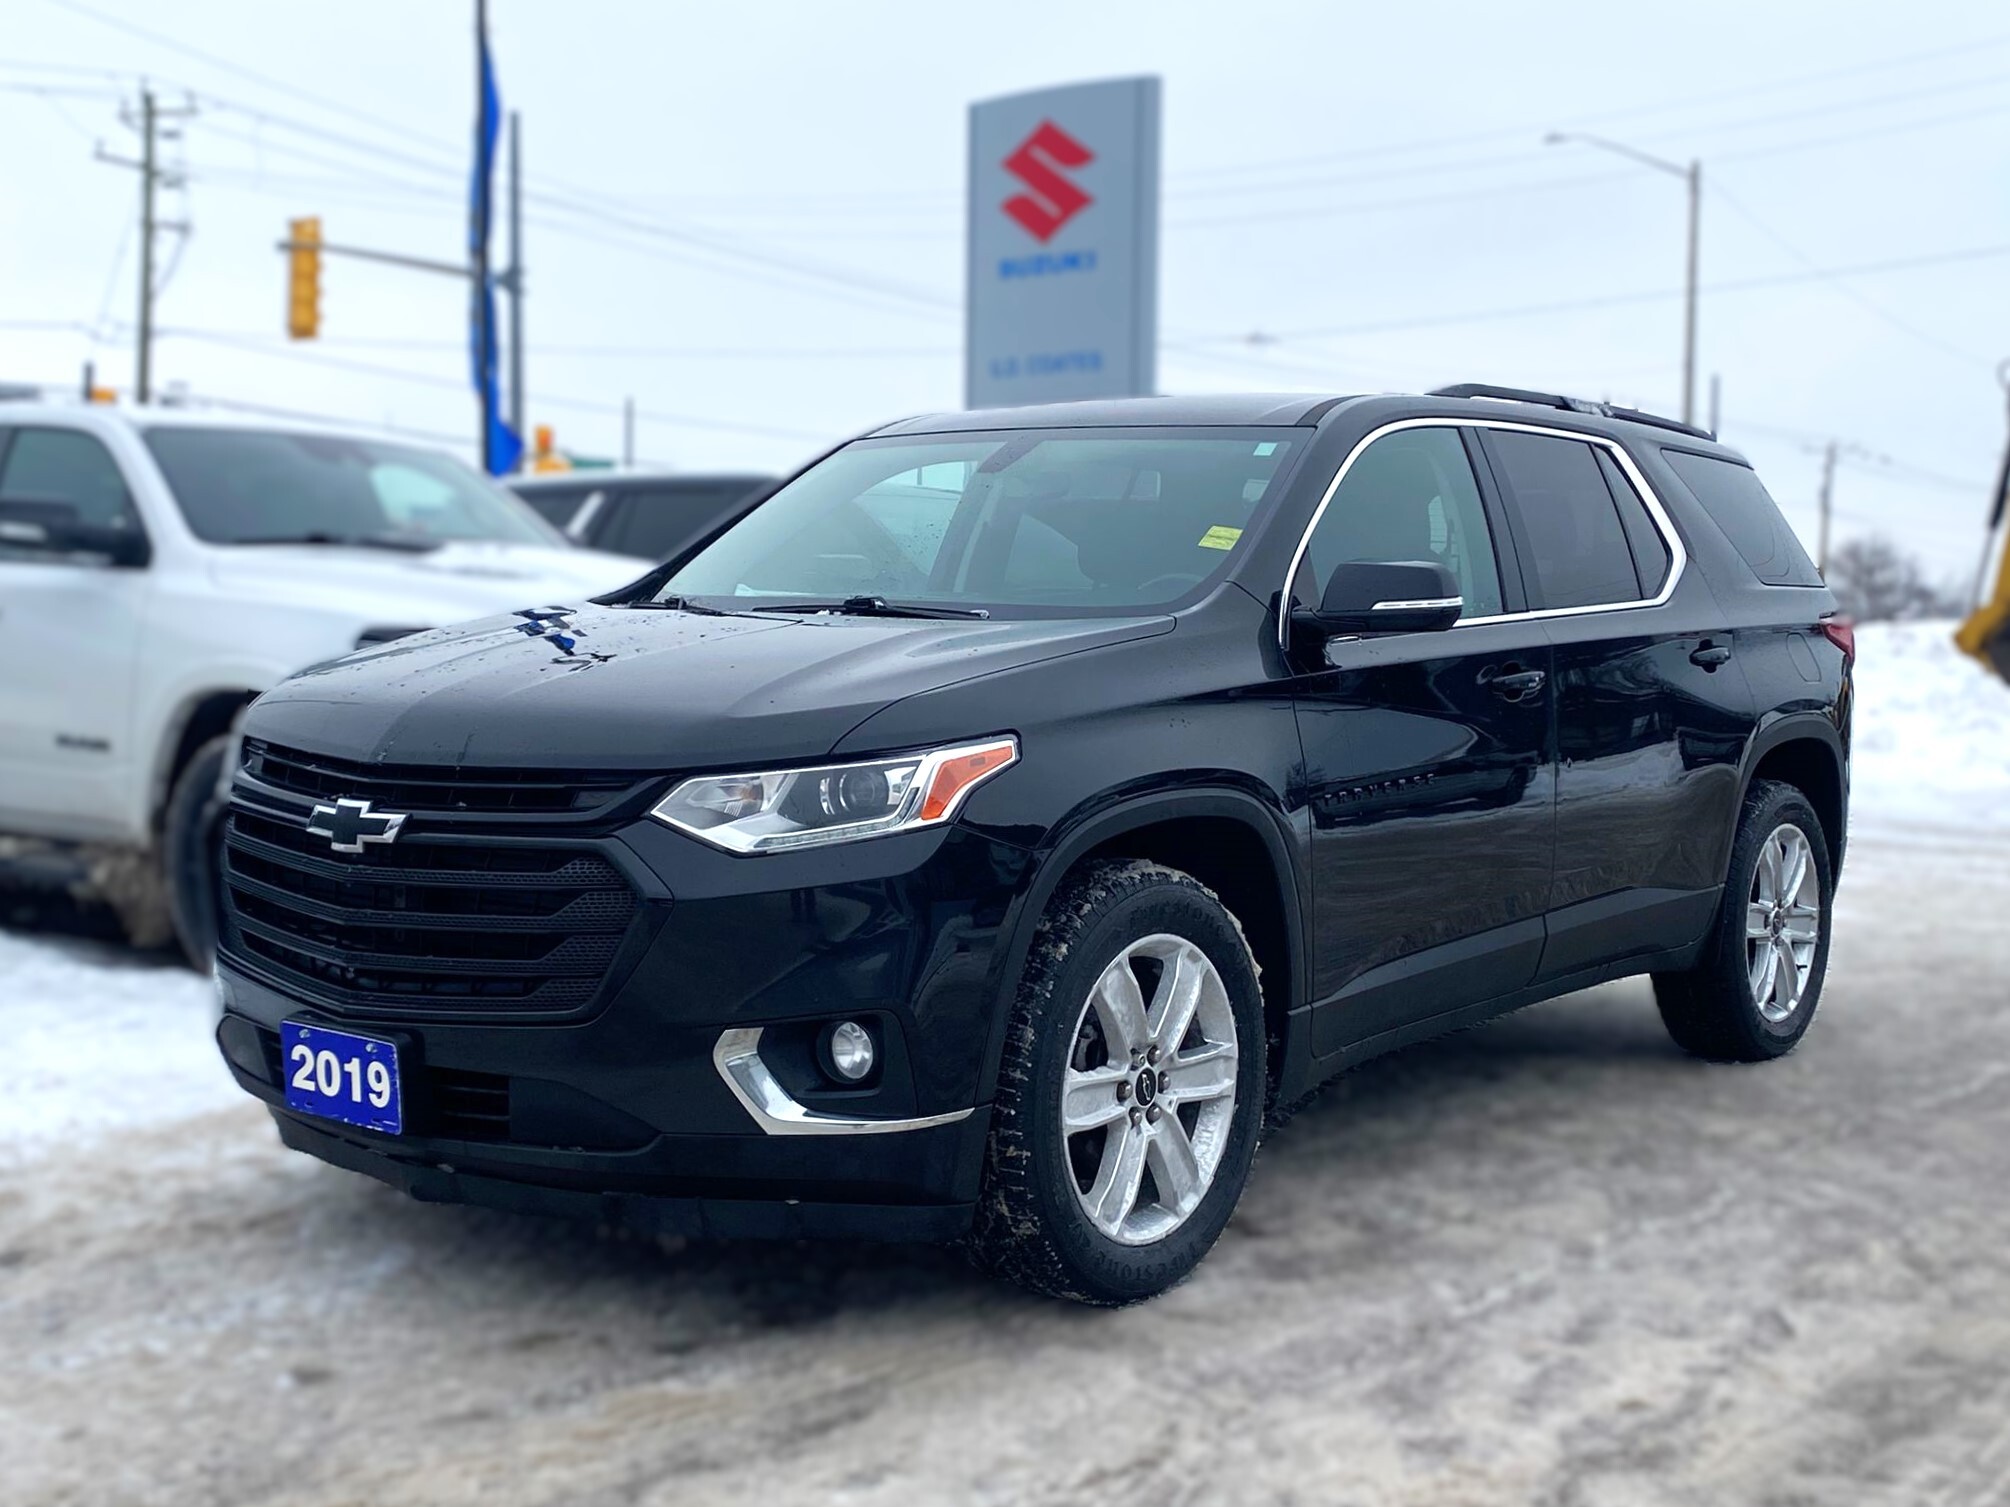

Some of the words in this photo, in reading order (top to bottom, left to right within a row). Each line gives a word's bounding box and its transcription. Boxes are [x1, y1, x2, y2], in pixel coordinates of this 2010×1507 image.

[998, 250, 1097, 280] SUZUKI
[1324, 773, 1436, 806] TRAVERSE
[291, 1044, 391, 1108] 2019
